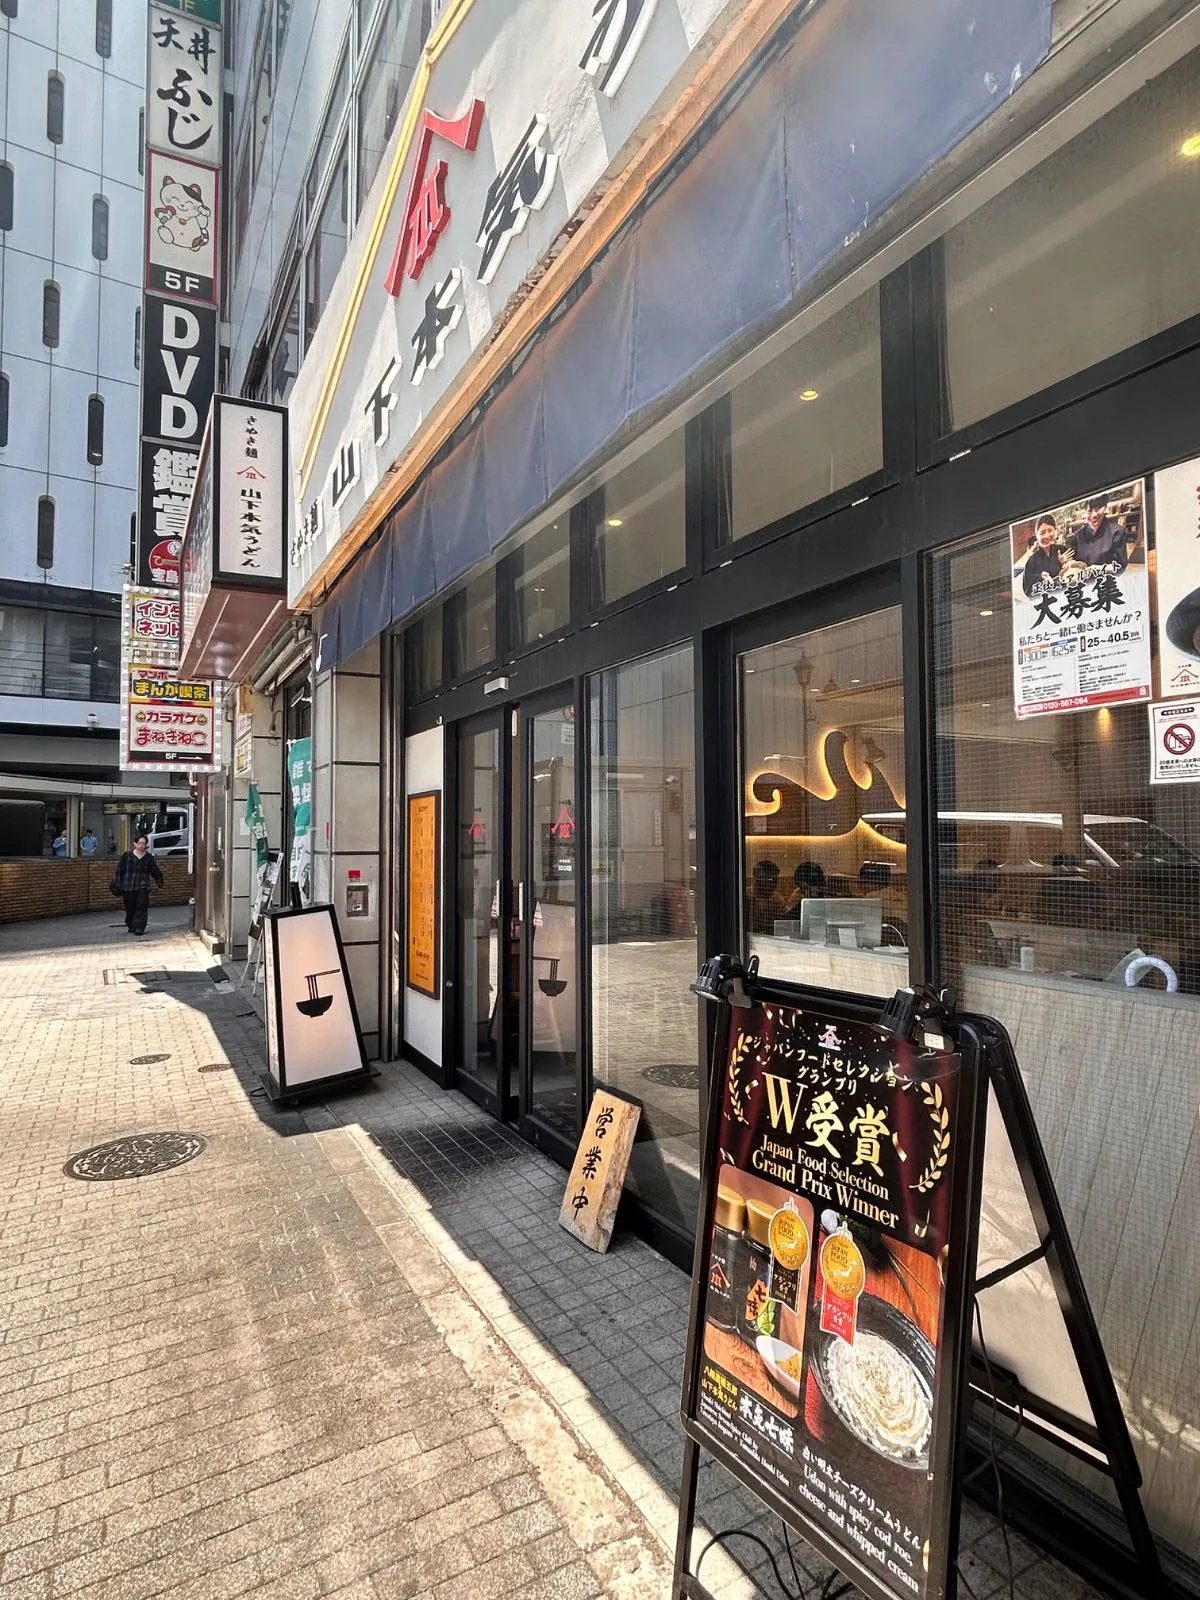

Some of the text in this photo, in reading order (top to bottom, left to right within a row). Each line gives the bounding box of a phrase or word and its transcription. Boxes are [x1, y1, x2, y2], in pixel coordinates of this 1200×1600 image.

[157, 69, 213, 150] ふじ
[164, 271, 200, 293] 5F
[160, 303, 201, 439] DVD
[1030, 576, 1126, 630] 大募集
[135, 681, 207, 699] まんが喫茶
[146, 711, 198, 724] カラオケ
[135, 726, 208, 747] まねきねこ
[165, 752, 177, 760] 5F
[753, 1034, 920, 1092] ジャパンフードセレクション
[797, 1065, 858, 1096] グランプリ
[572, 1106, 615, 1222] 営業中
[752, 1149, 900, 1229] Grand Prix Winner
[760, 1134, 889, 1200] Japan Food Selection
[803, 1464, 827, 1493] Udon
[828, 1488, 847, 1511] with
[848, 1504, 872, 1531] spicy
[874, 1525, 892, 1547] cod
[798, 1483, 919, 1593] cheese and whipped cream
